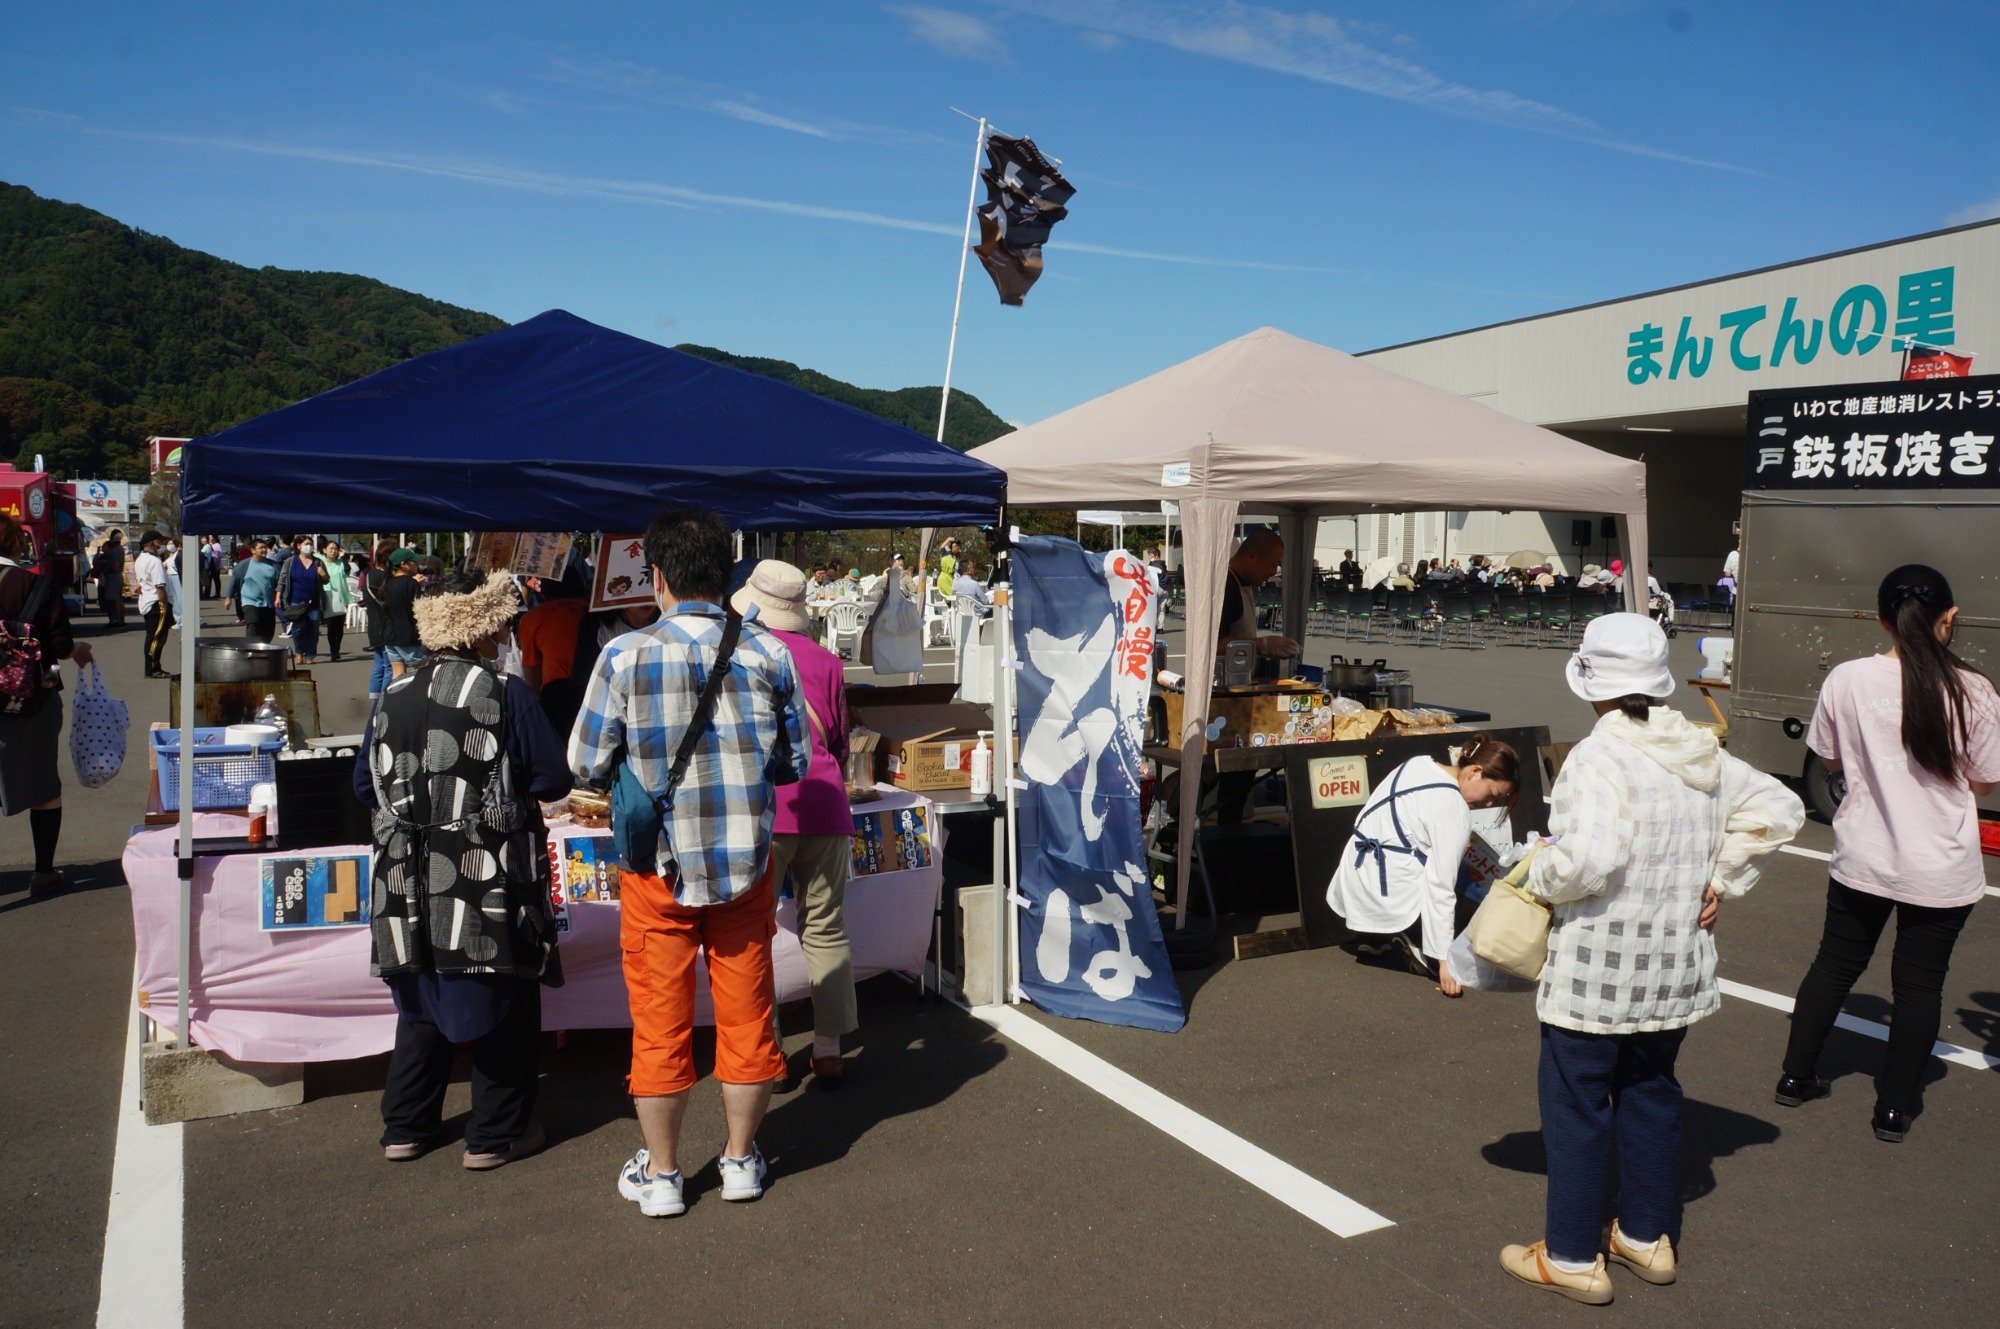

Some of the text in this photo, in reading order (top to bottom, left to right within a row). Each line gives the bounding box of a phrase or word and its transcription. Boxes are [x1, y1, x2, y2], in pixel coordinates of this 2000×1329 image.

[1627, 266, 1955, 385] まんてんの里
[1756, 416, 1787, 474] 二戸
[1791, 430, 2000, 479] 鉄板焼き
[1319, 780, 1360, 797] OPEN
[1320, 762, 1344, 777] Come
[1020, 612, 1153, 1003] そば
[598, 860, 611, 902] 400円
[1464, 845, 1501, 880] ホットド
